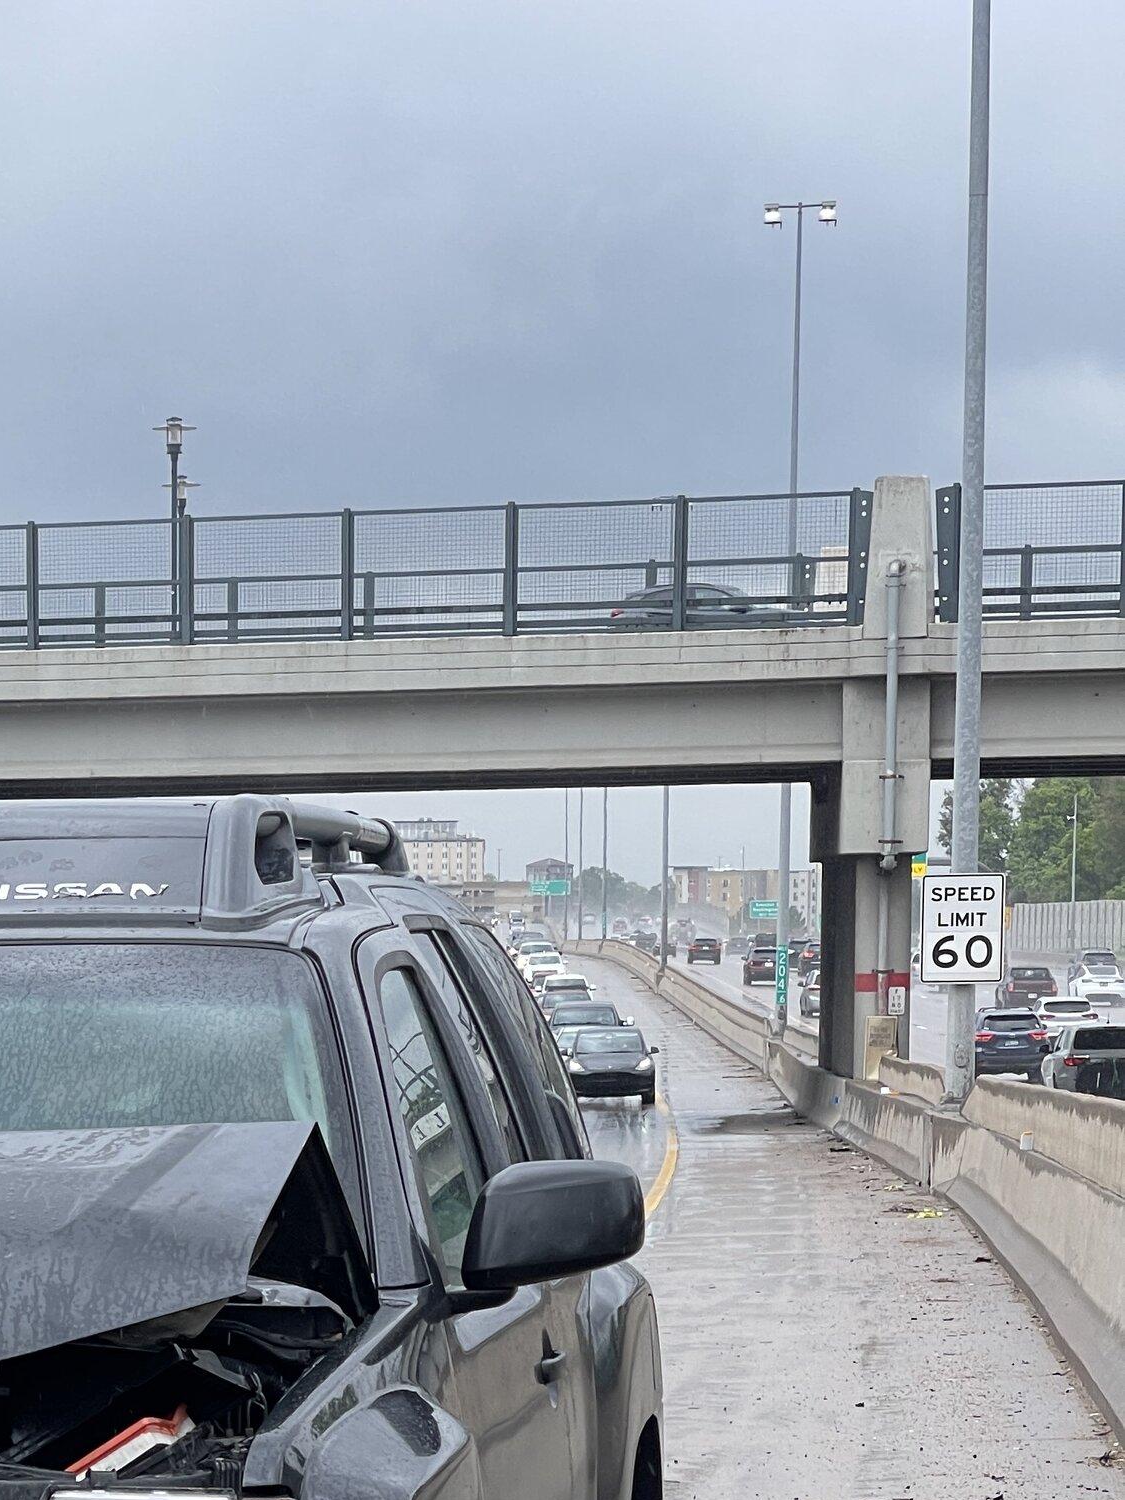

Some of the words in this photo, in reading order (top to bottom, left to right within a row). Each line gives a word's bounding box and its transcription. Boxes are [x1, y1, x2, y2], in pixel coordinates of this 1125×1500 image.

[931, 887, 996, 902] SPEED
[938, 912, 987, 927] LIMIT
[932, 935, 993, 968] 60
